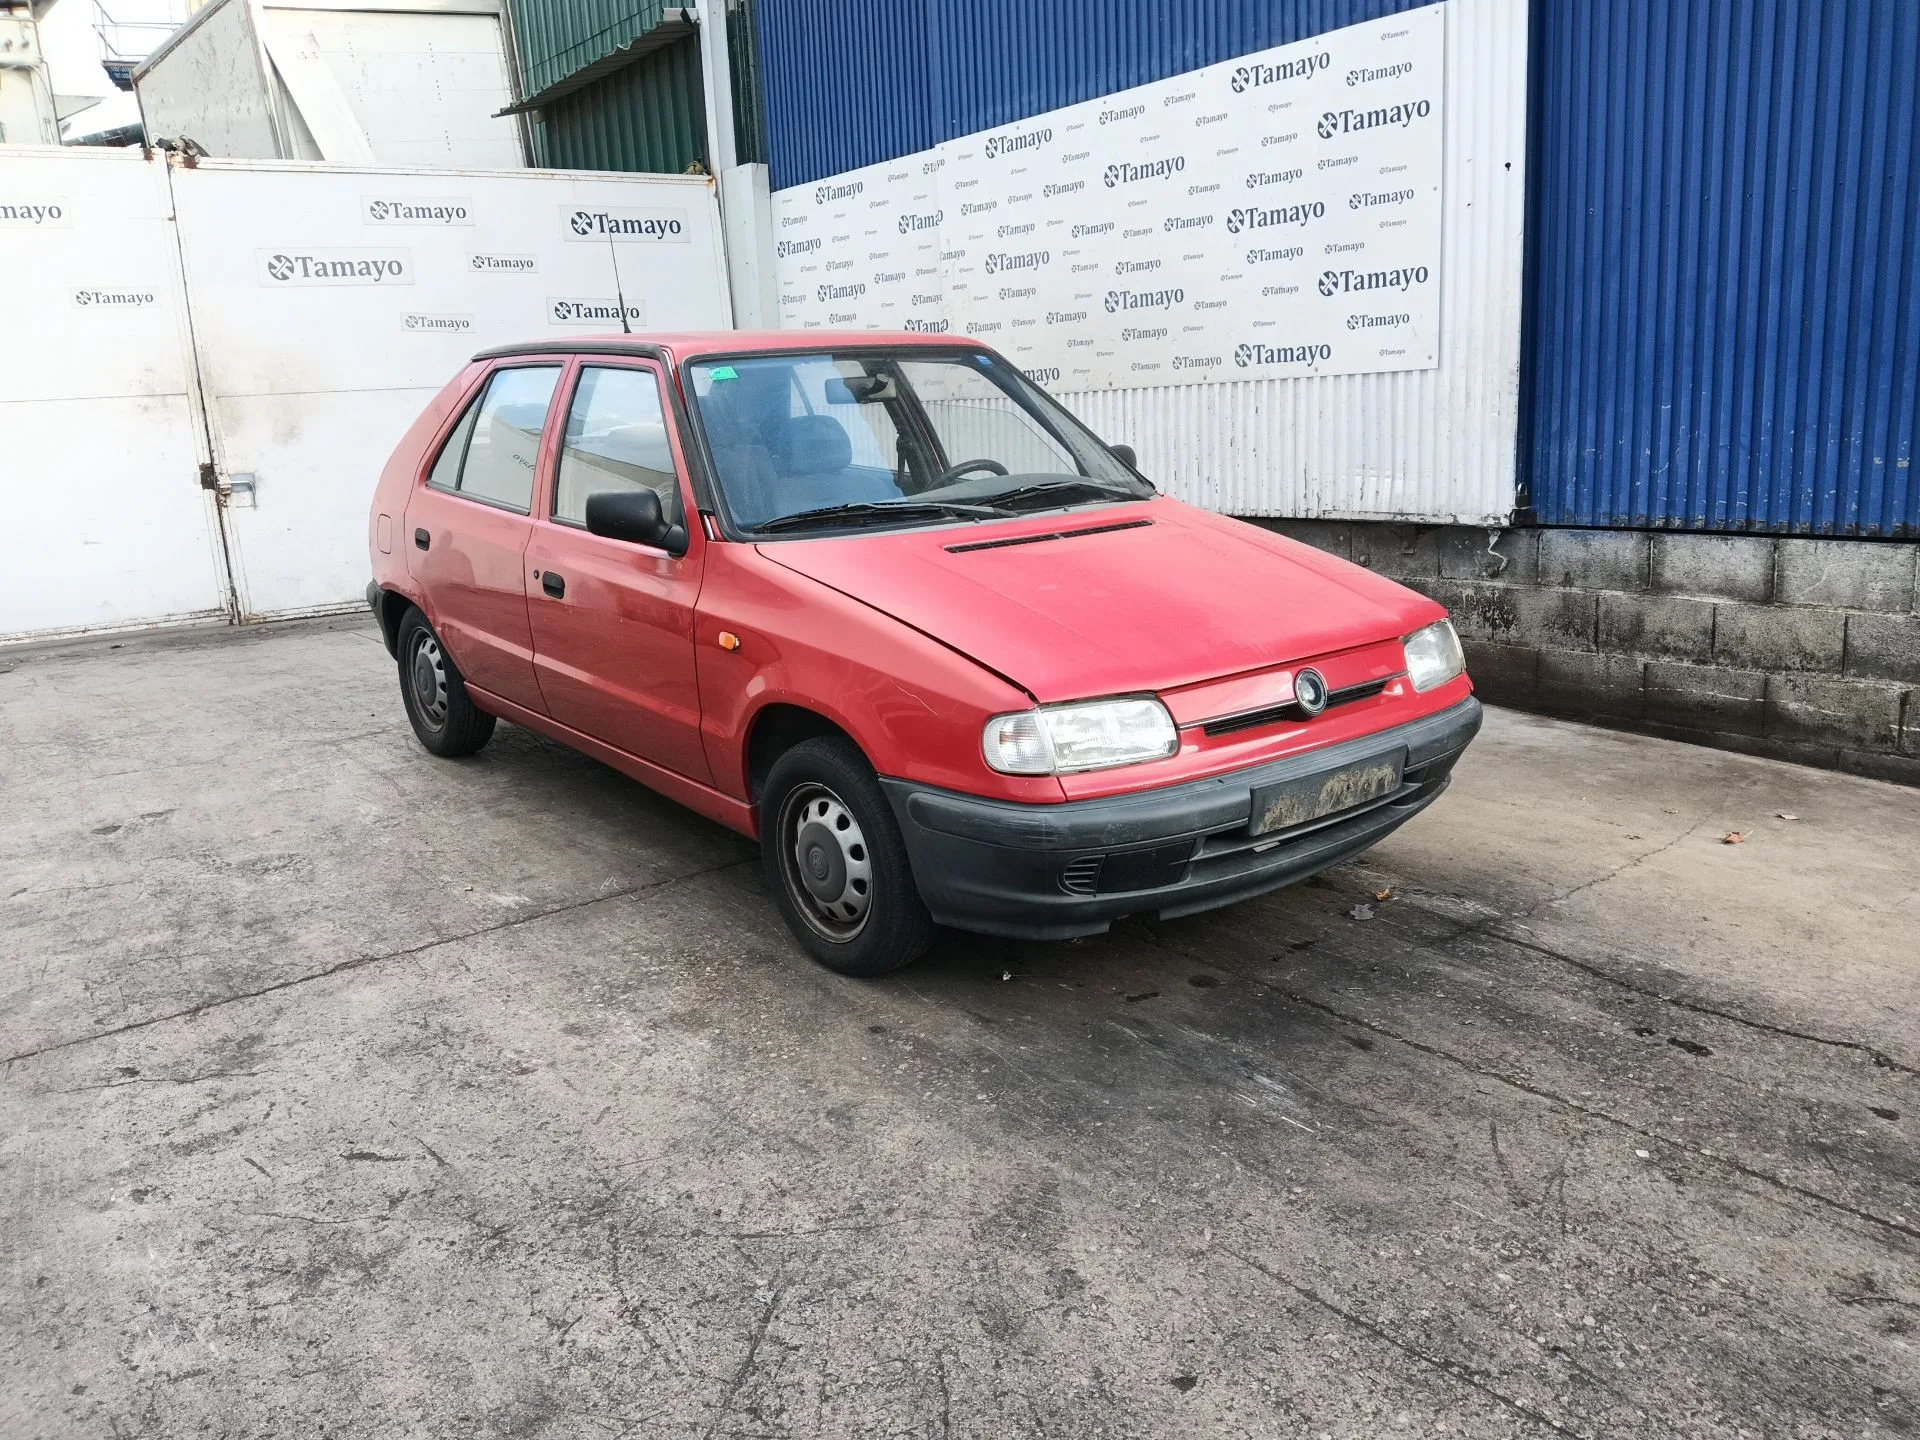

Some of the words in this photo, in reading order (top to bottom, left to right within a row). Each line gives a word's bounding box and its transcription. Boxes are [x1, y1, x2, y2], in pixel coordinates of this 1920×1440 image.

[1250, 52, 1330, 87] Tamayo
[1359, 62, 1412, 82] Tamayo
[1170, 93, 1195, 104] Tamayo
[1109, 105, 1145, 122] Tamayo
[1202, 113, 1227, 124] Tamayo
[1339, 100, 1430, 133] Tamayo
[999, 128, 1052, 154] Tamayo
[1269, 133, 1298, 145] Tamayo
[1325, 156, 1358, 167] Tamayo
[1120, 156, 1184, 183] Tamayo
[1257, 169, 1302, 185] Tamayo
[825, 182, 863, 201] Tamayo
[1051, 181, 1084, 195] Tamayo
[1195, 184, 1220, 194] Tamayo
[1362, 189, 1414, 206] Tamayo
[390, 203, 466, 223] Tamayo
[968, 201, 997, 214] Tamayo
[1173, 215, 1213, 229] Tamayo
[1246, 202, 1324, 229] Tamayo
[593, 213, 681, 239] Tamayo
[1005, 223, 1035, 235] Tamayo
[1081, 222, 1114, 236] Tamayo
[1129, 228, 1152, 237] Tamayo
[786, 238, 821, 255] Tamayo
[1333, 242, 1364, 252] Tamayo
[998, 251, 1049, 271] Tamayo
[1258, 247, 1303, 261] Tamayo
[295, 257, 402, 282] Tamayo
[485, 257, 533, 270] Tamayo
[1124, 260, 1161, 272] Tamayo
[881, 272, 905, 283] Tamayo
[1340, 266, 1428, 292] Tamayo
[827, 284, 865, 300] Tamayo
[1006, 288, 1036, 298] Tamayo
[1270, 286, 1298, 295] Tamayo
[92, 292, 153, 306] Tamayo
[1120, 289, 1184, 310] Tamayo
[1201, 301, 1227, 309] Tamayo
[572, 303, 640, 323] Tamayo
[1055, 312, 1087, 323] Tamayo
[420, 317, 469, 331] Tamayo
[974, 322, 1001, 333] Tamayo
[1360, 314, 1409, 328] Tamayo
[1132, 328, 1167, 340] Tamayo
[1253, 344, 1331, 367] Tamayo
[1137, 363, 1160, 371] Tamayo
[1183, 357, 1222, 369] Tamayo
